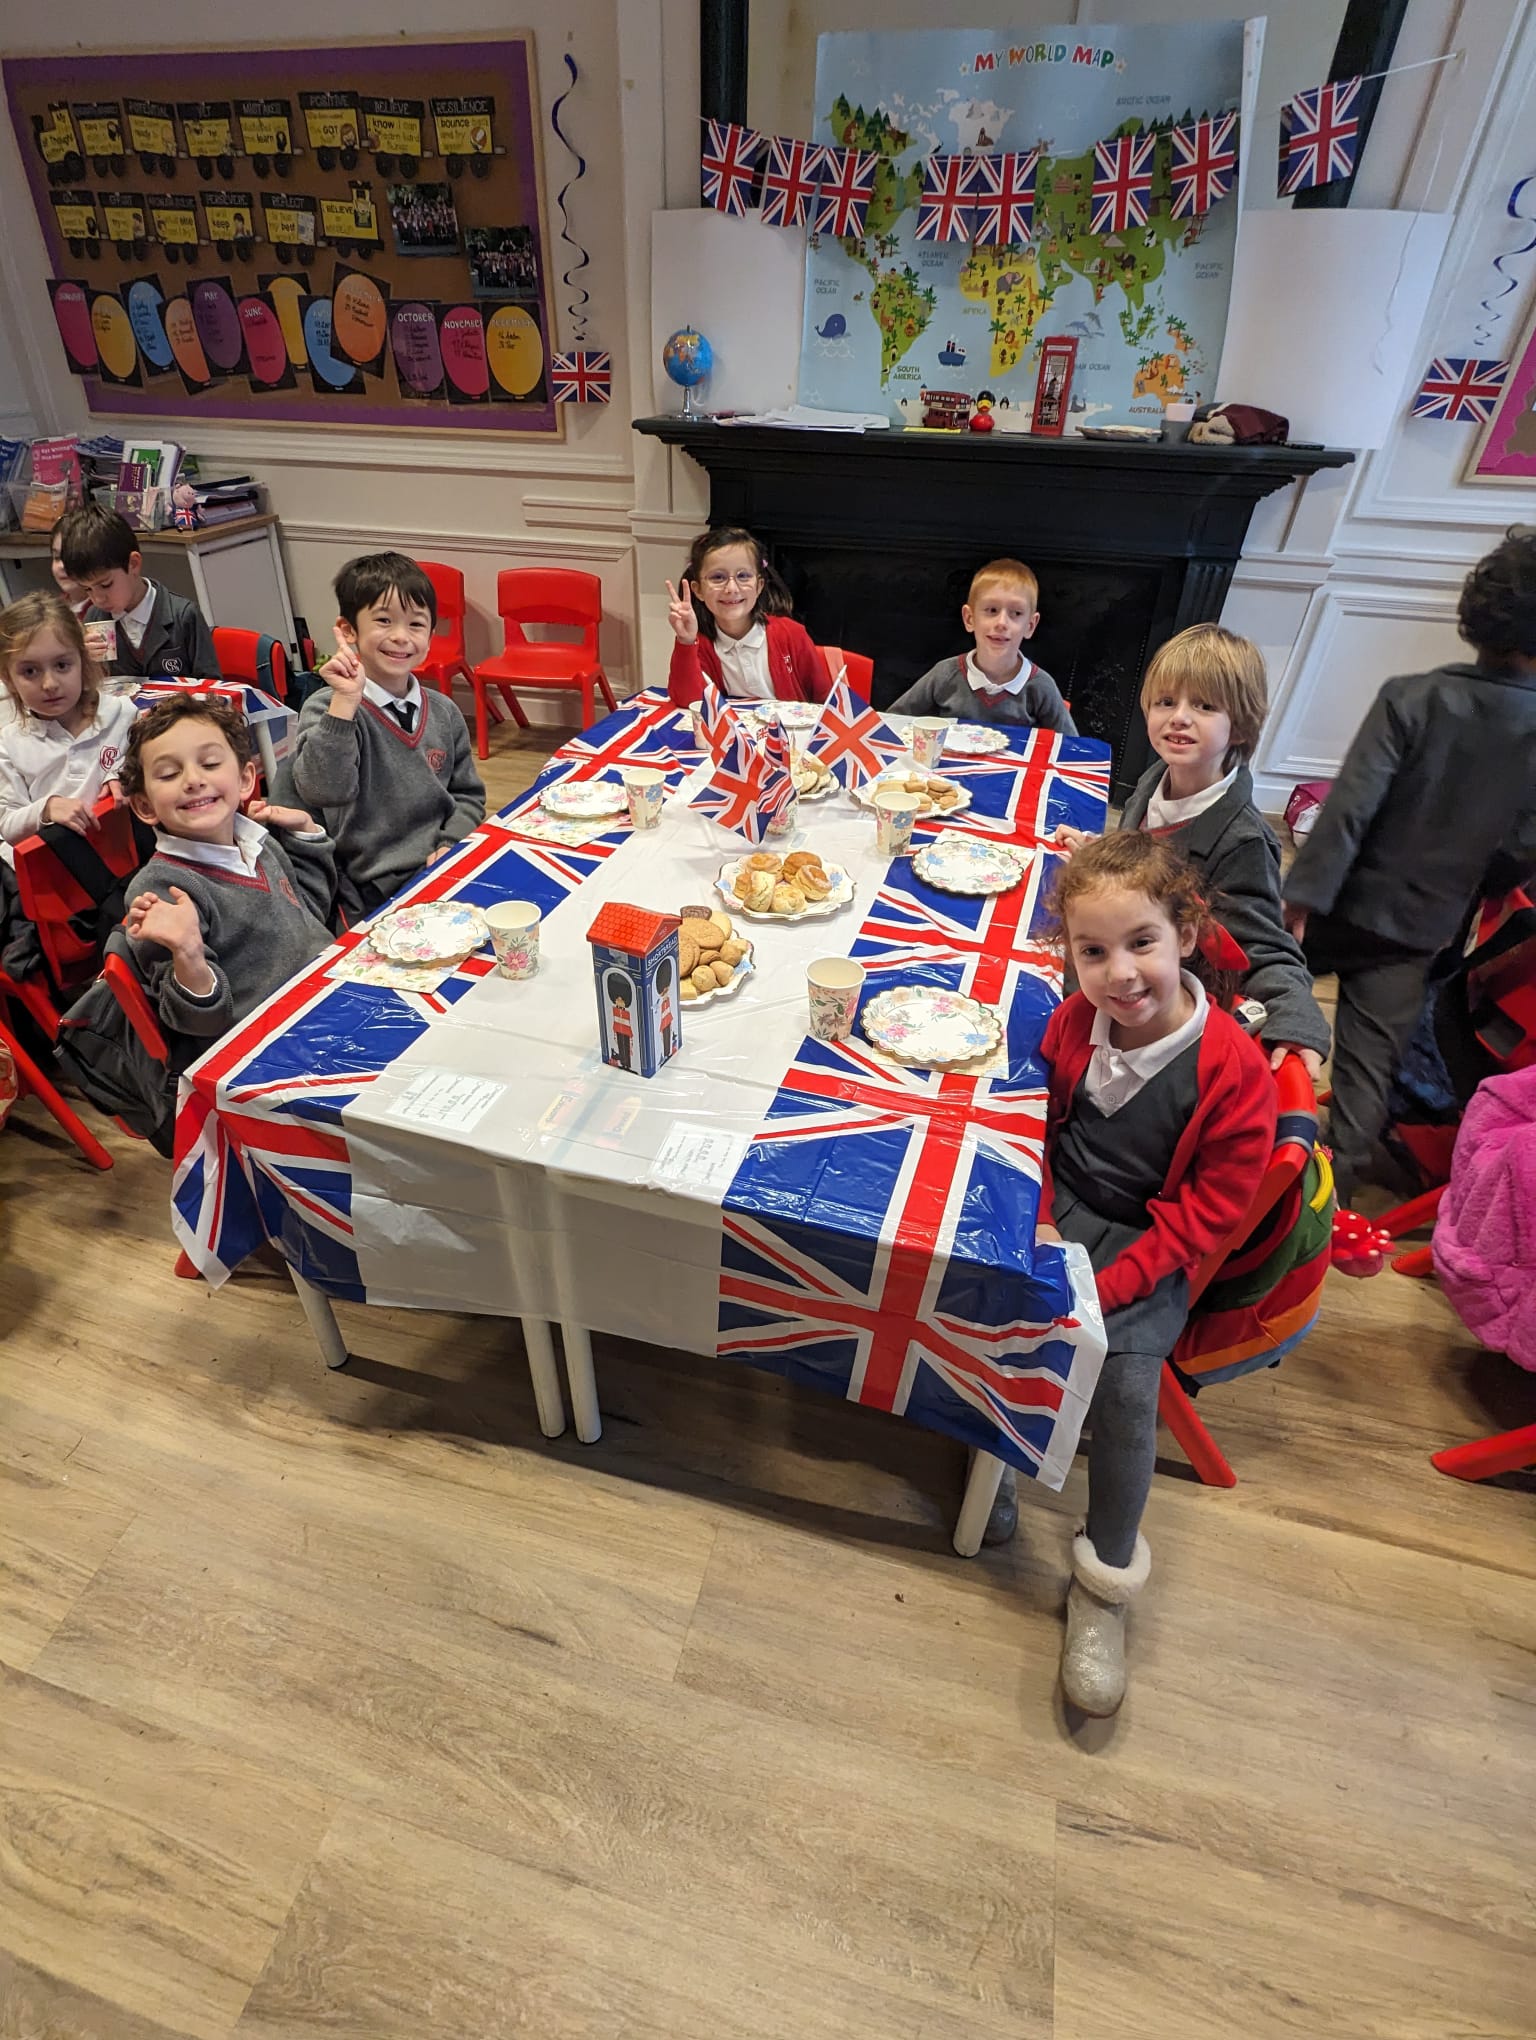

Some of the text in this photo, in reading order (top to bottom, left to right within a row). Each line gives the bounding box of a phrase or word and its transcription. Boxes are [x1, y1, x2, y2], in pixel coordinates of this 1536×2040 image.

[974, 42, 1115, 73] MY WORLD MAP
[310, 94, 349, 107] POSITIVE
[374, 101, 409, 115] BELIEVE
[435, 99, 489, 114] RESILIENCE
[372, 118, 395, 129] know
[440, 118, 470, 129] bounce
[922, 259, 944, 268] OCEAN
[815, 286, 838, 295] OCEAN
[397, 312, 435, 323] OCTOBER
[896, 365, 920, 373] SOUTH
[1088, 363, 1111, 371] OCEAN
[892, 373, 922, 381] AMERICA
[1128, 406, 1166, 414] AUSTRALIA
[647, 936, 678, 967] SHORTBREAD
